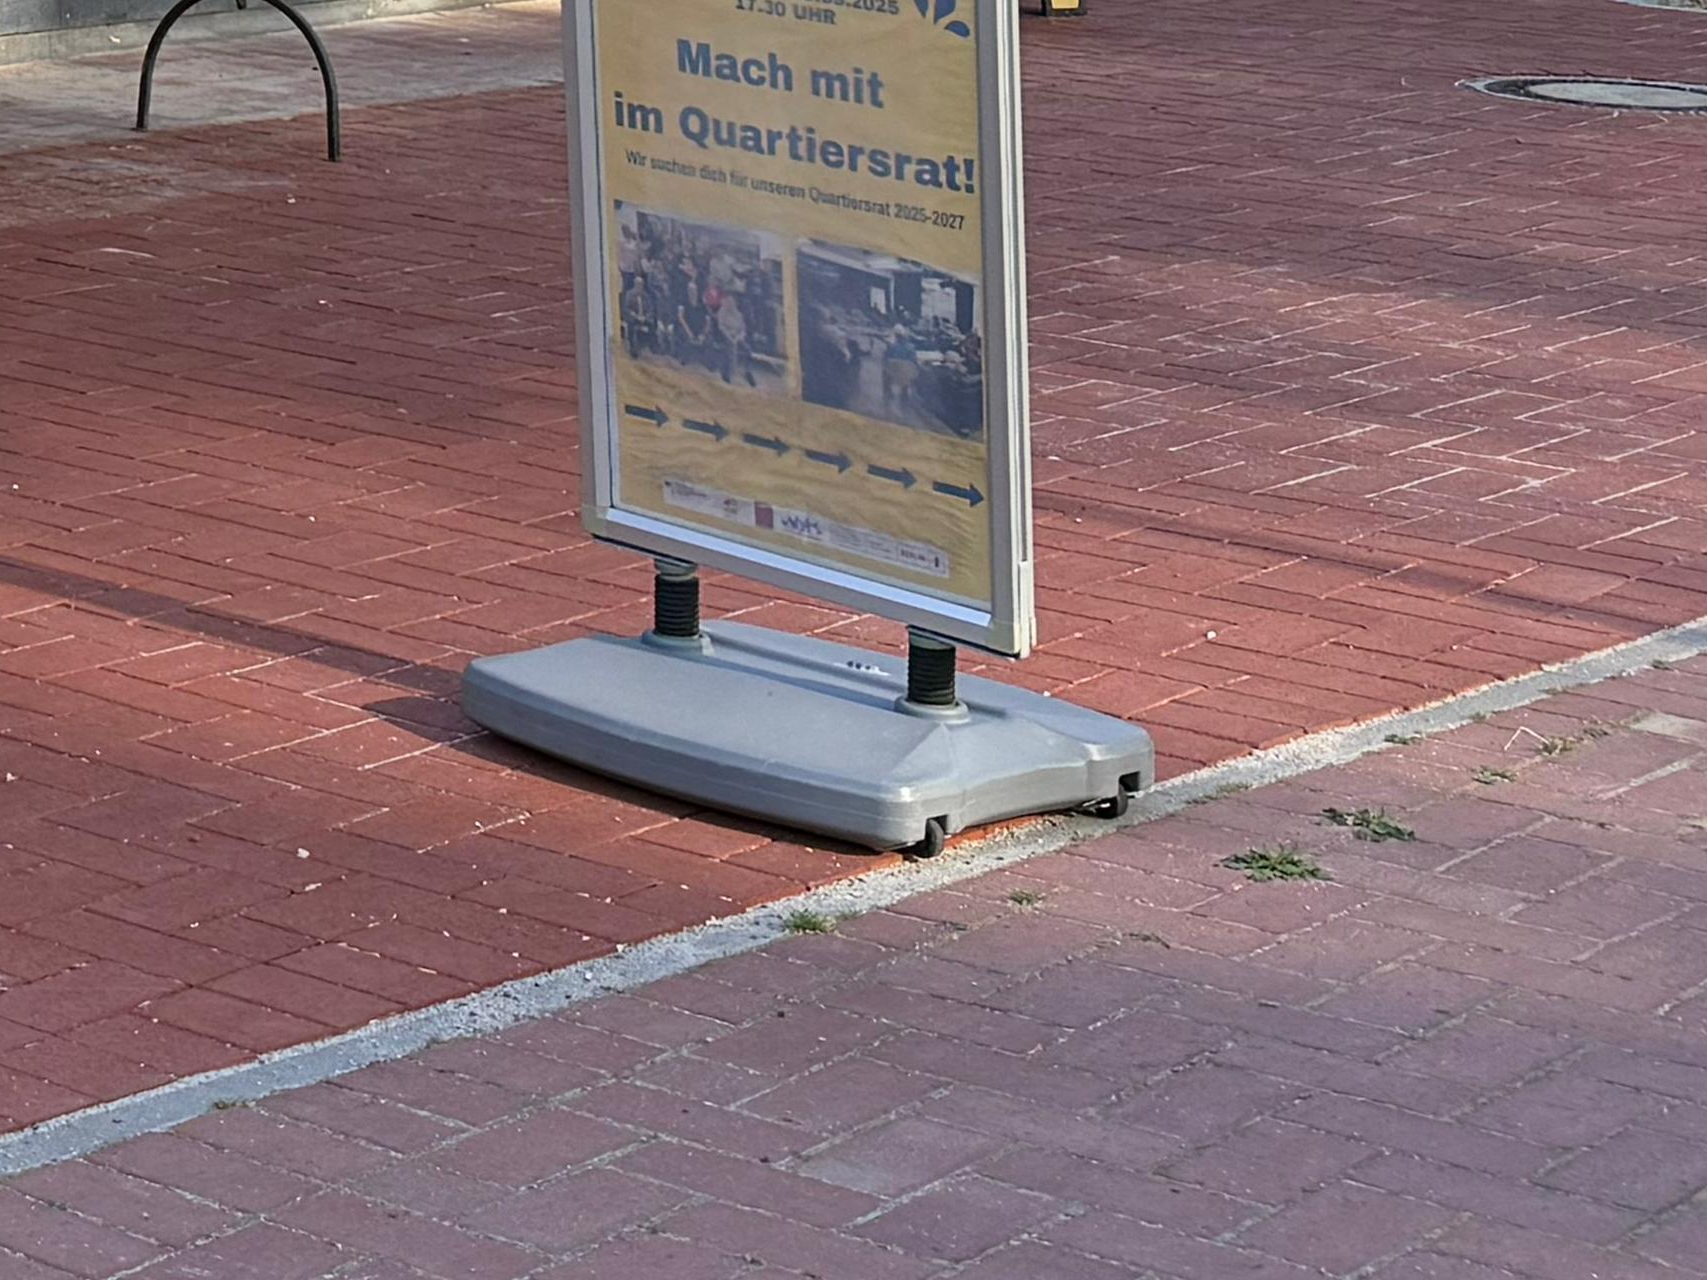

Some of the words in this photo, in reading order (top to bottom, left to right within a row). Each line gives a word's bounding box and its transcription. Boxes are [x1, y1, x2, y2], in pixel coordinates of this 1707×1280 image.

[792, 3, 837, 25] UHR
[676, 38, 794, 92] Mach
[810, 68, 885, 109] mit
[613, 92, 664, 135] im
[679, 105, 977, 195] Quartiersrat!
[625, 148, 647, 167] Wir
[699, 165, 727, 184] dich
[750, 178, 806, 200] unseren
[808, 186, 891, 217] Quartiersrat
[893, 201, 966, 231] 2025-2027
